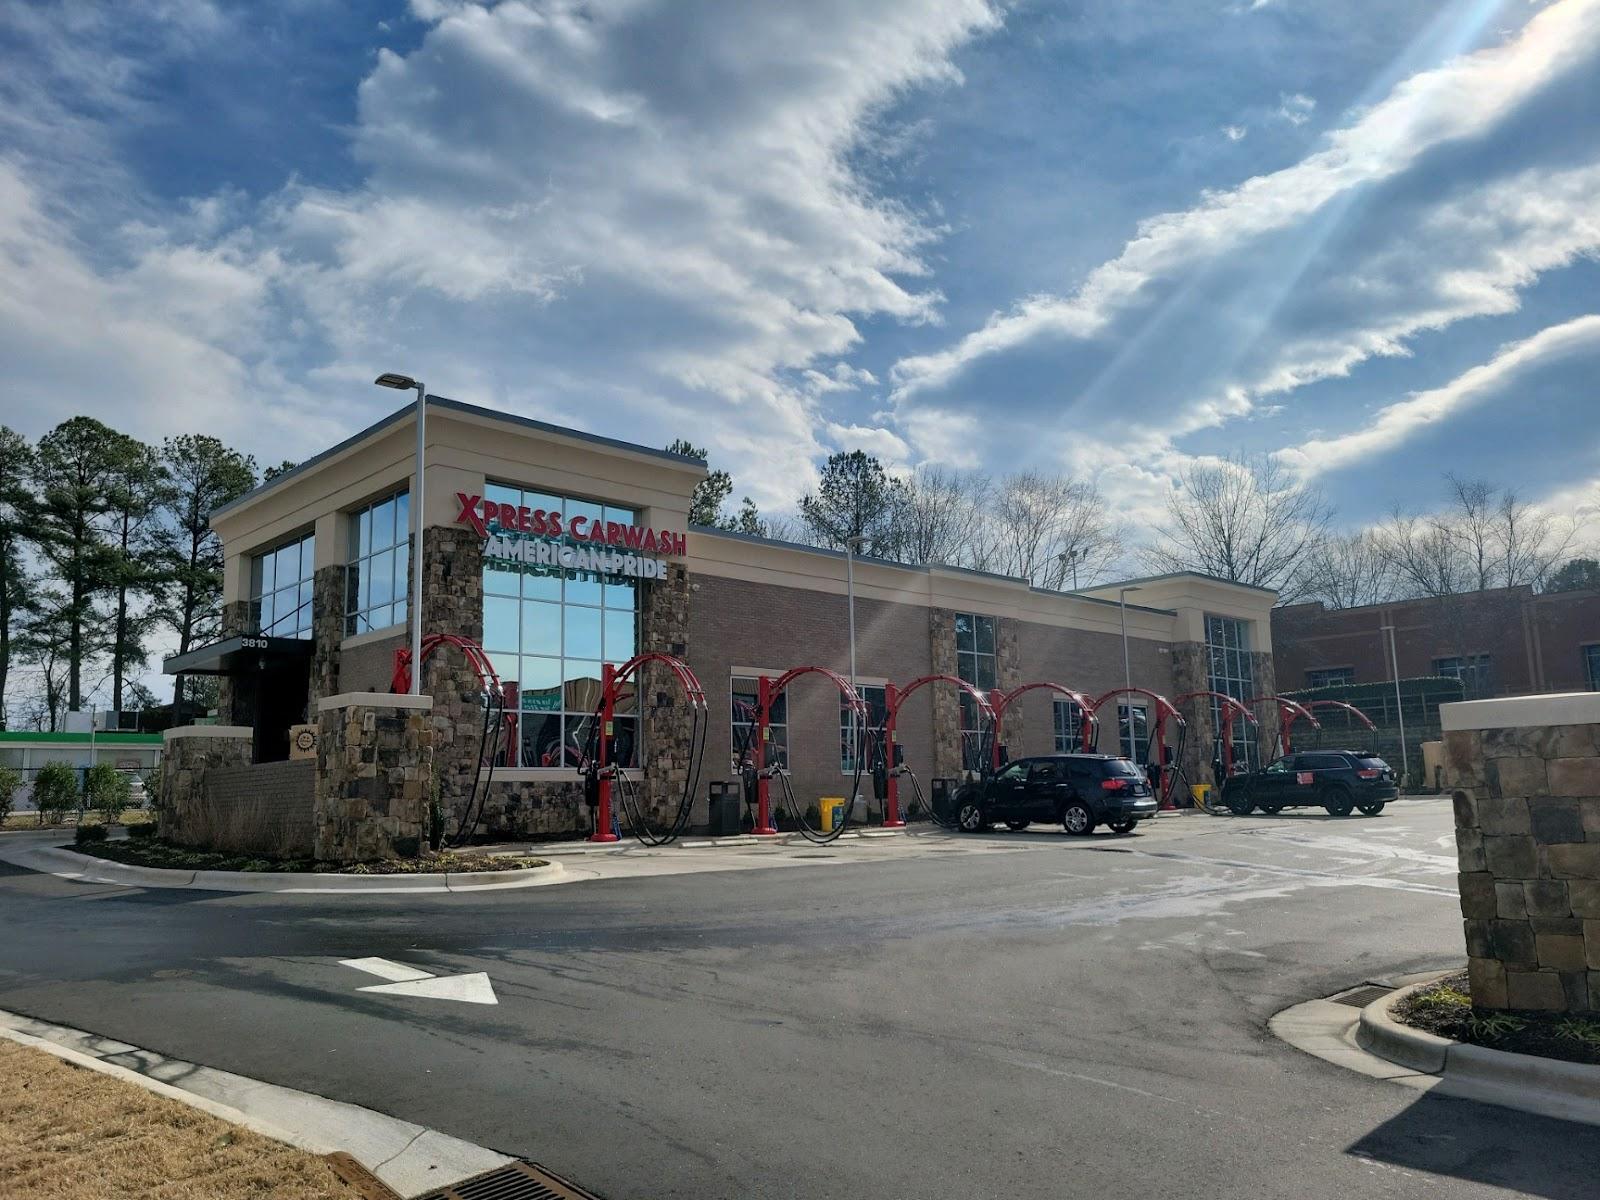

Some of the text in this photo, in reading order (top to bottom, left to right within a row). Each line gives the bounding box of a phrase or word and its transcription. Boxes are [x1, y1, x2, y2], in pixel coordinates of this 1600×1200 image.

[456, 493, 687, 557] XPRESS CARWASH
[482, 535, 668, 580] AMERICAN PRIDE
[241, 637, 269, 649] 3810
